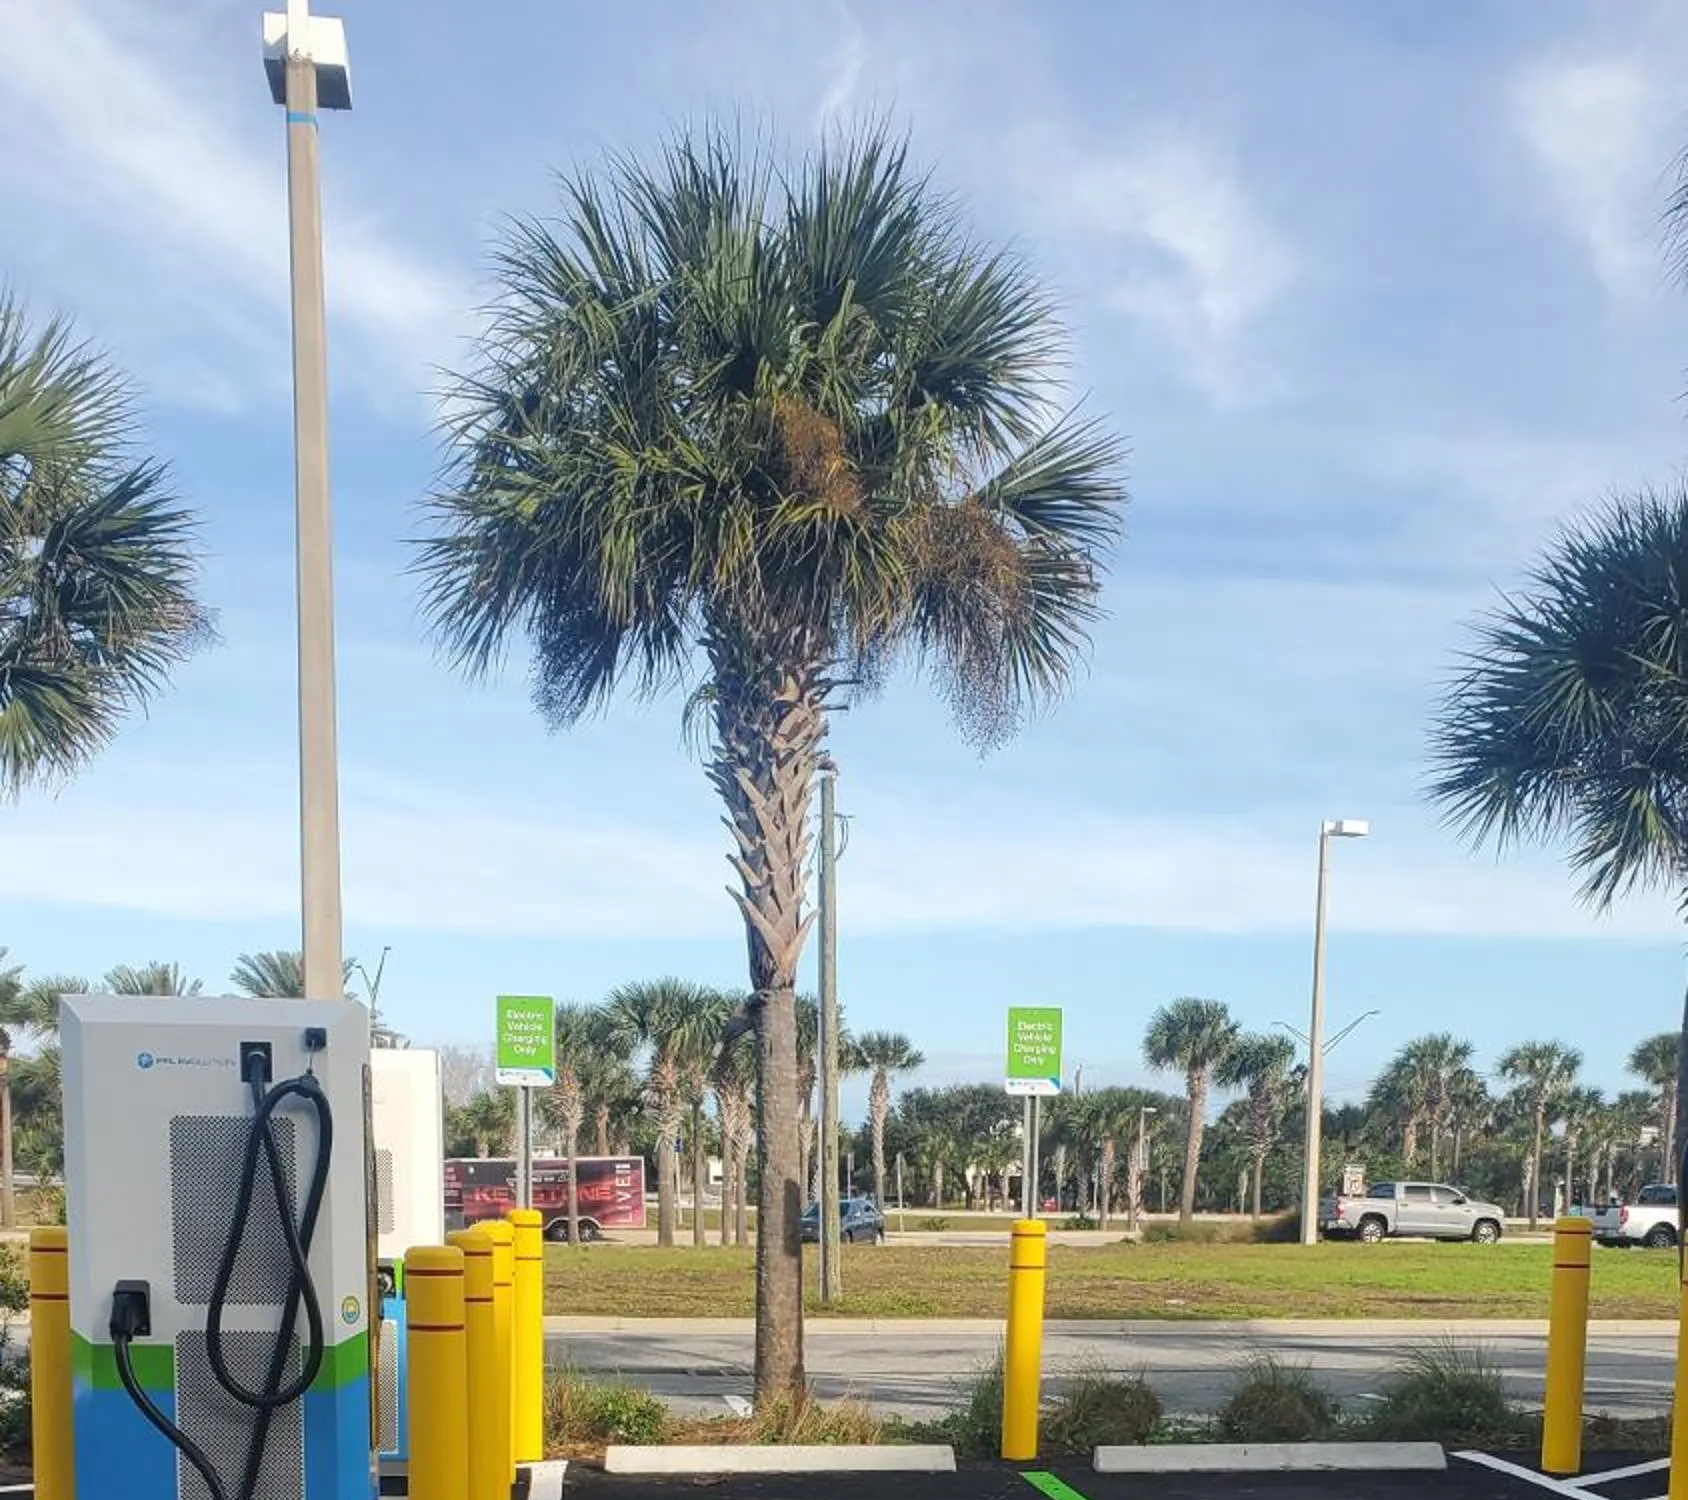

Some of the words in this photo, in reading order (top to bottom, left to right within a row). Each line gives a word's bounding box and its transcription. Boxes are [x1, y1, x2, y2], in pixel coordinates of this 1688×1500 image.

[506, 1009, 545, 1019] Electric
[507, 1020, 543, 1031] Vehicle
[1018, 1021, 1053, 1031] Electric
[503, 1033, 547, 1045] Charging
[1017, 1032, 1053, 1042] Vehicle
[512, 1044, 537, 1056] Only
[1013, 1043, 1056, 1055] Charging
[1023, 1055, 1044, 1066] Only
